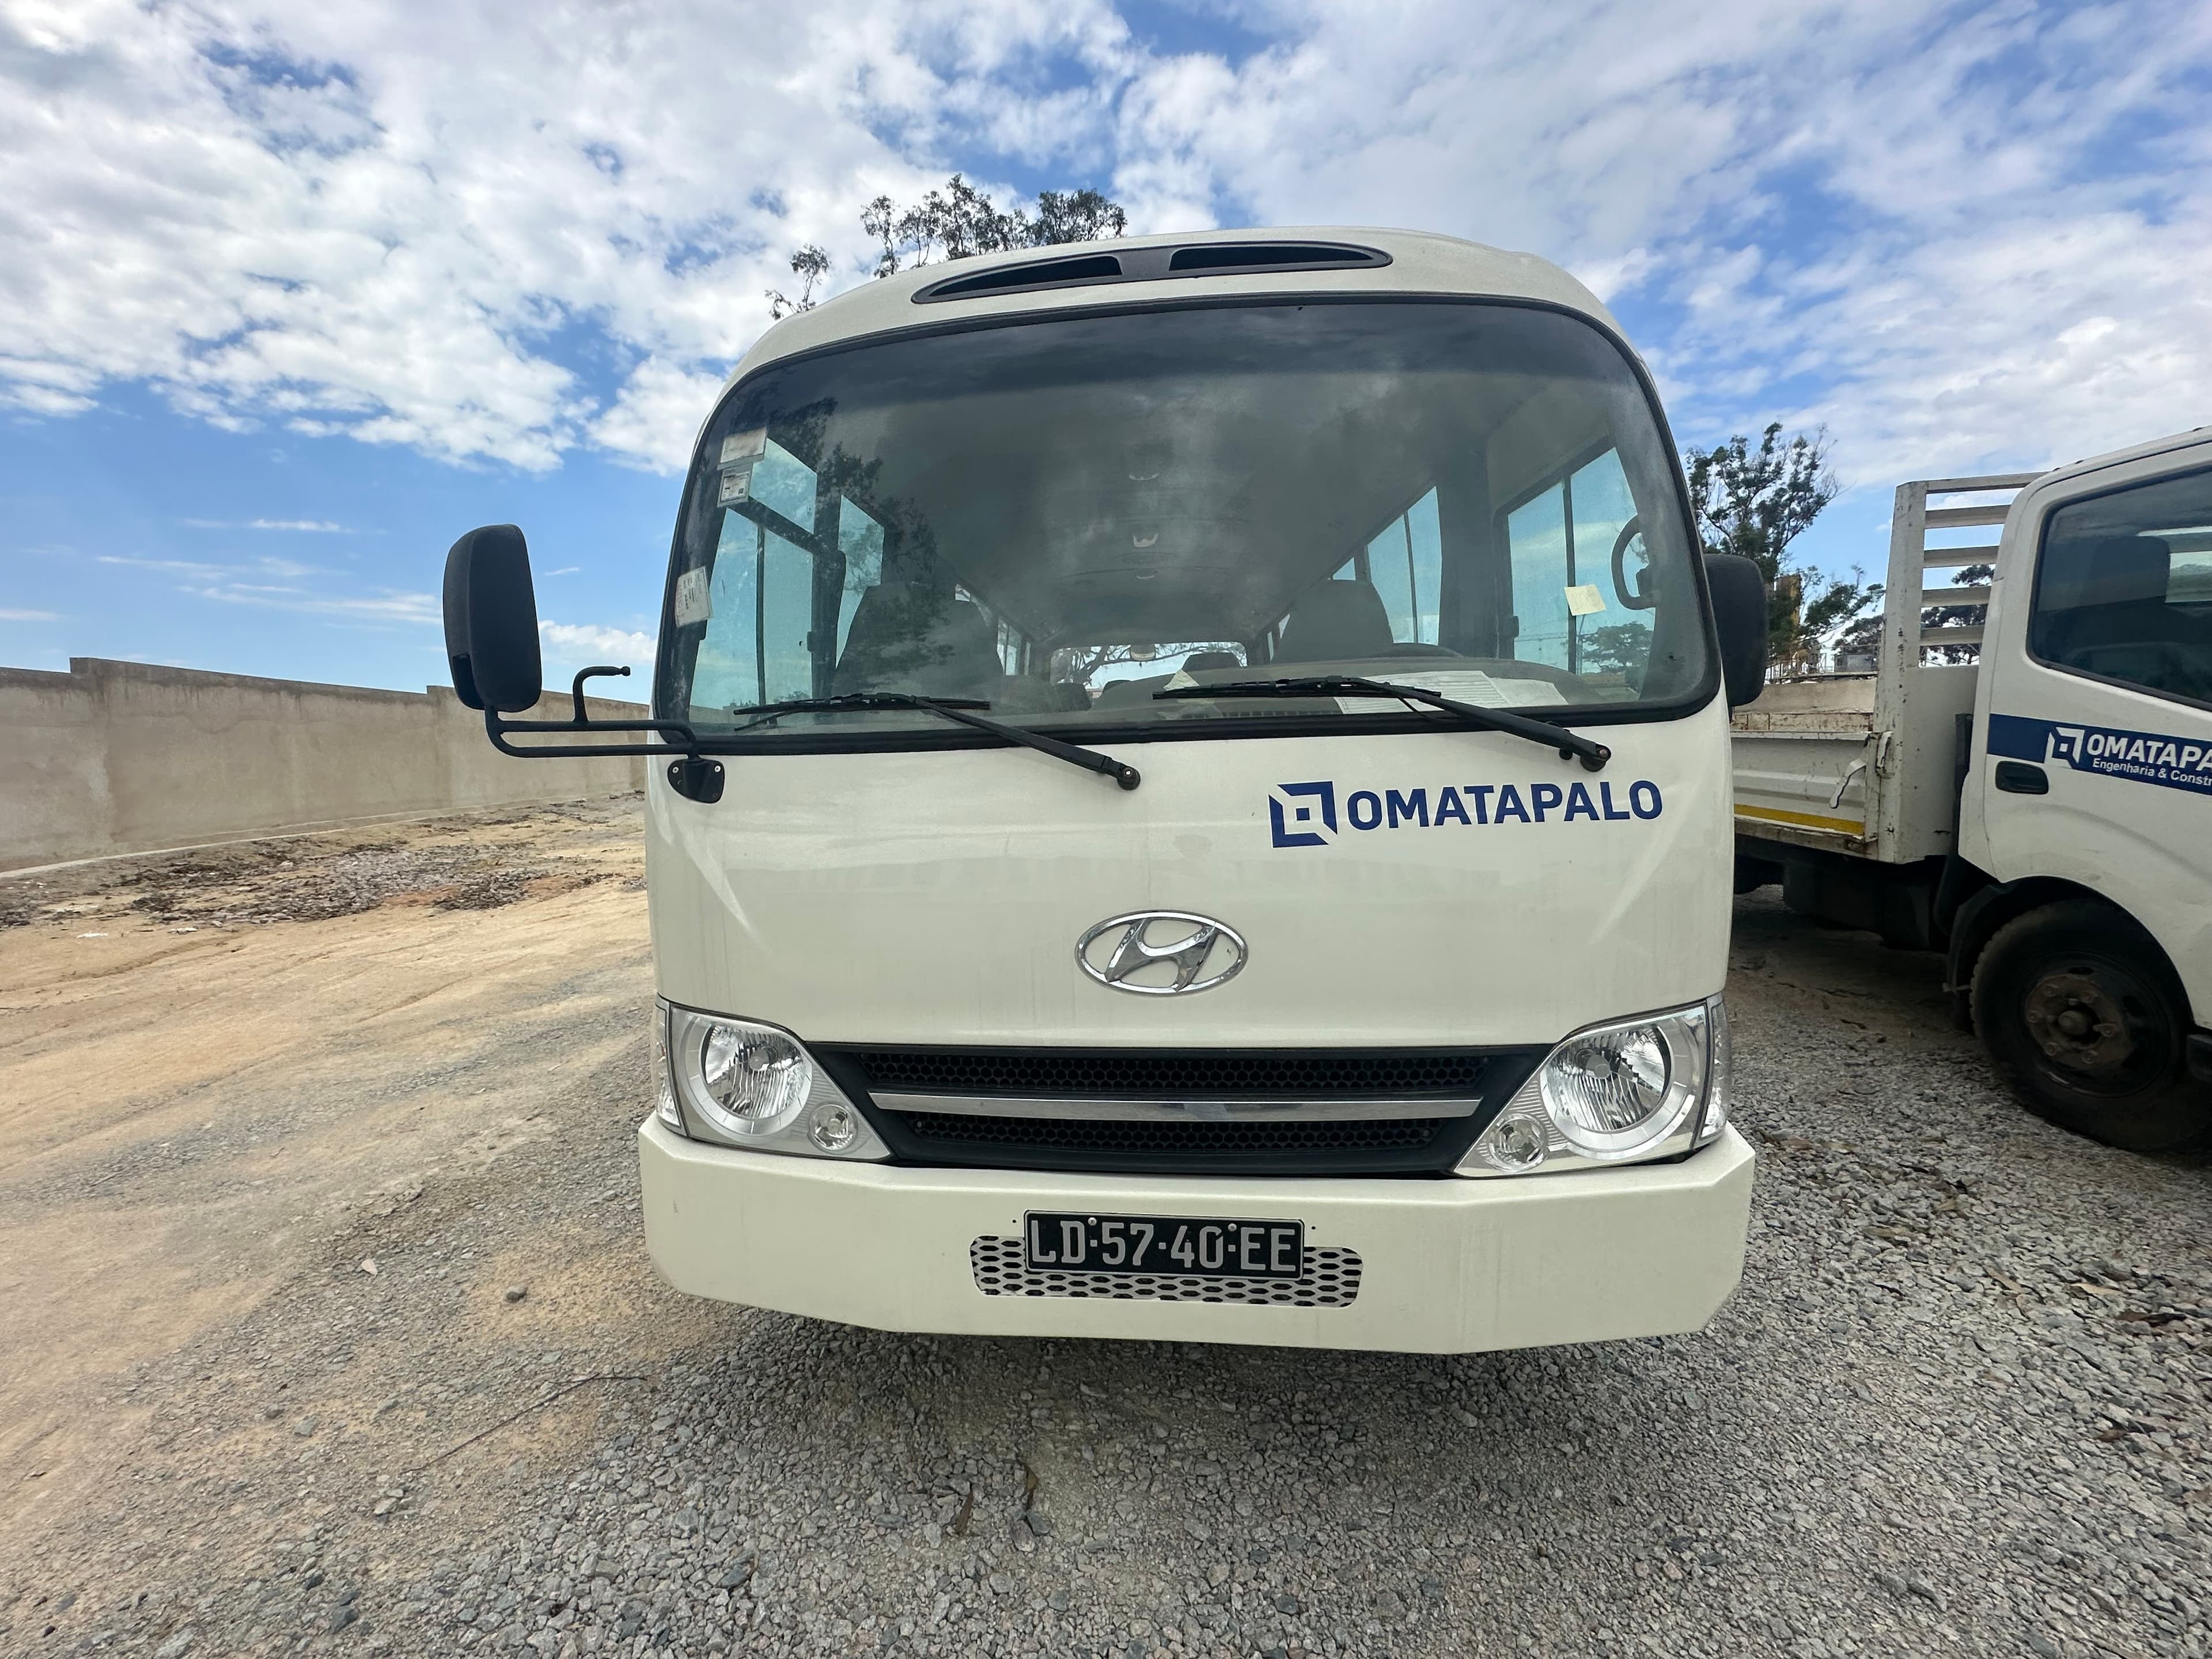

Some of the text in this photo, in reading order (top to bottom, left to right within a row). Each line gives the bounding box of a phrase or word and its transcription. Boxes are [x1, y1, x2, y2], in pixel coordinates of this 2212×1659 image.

[2086, 734, 2212, 771] OMATAPA
[2092, 758, 2154, 777] Engenharia
[2158, 768, 2166, 778] &
[1348, 780, 1662, 831] OMATAPALO
